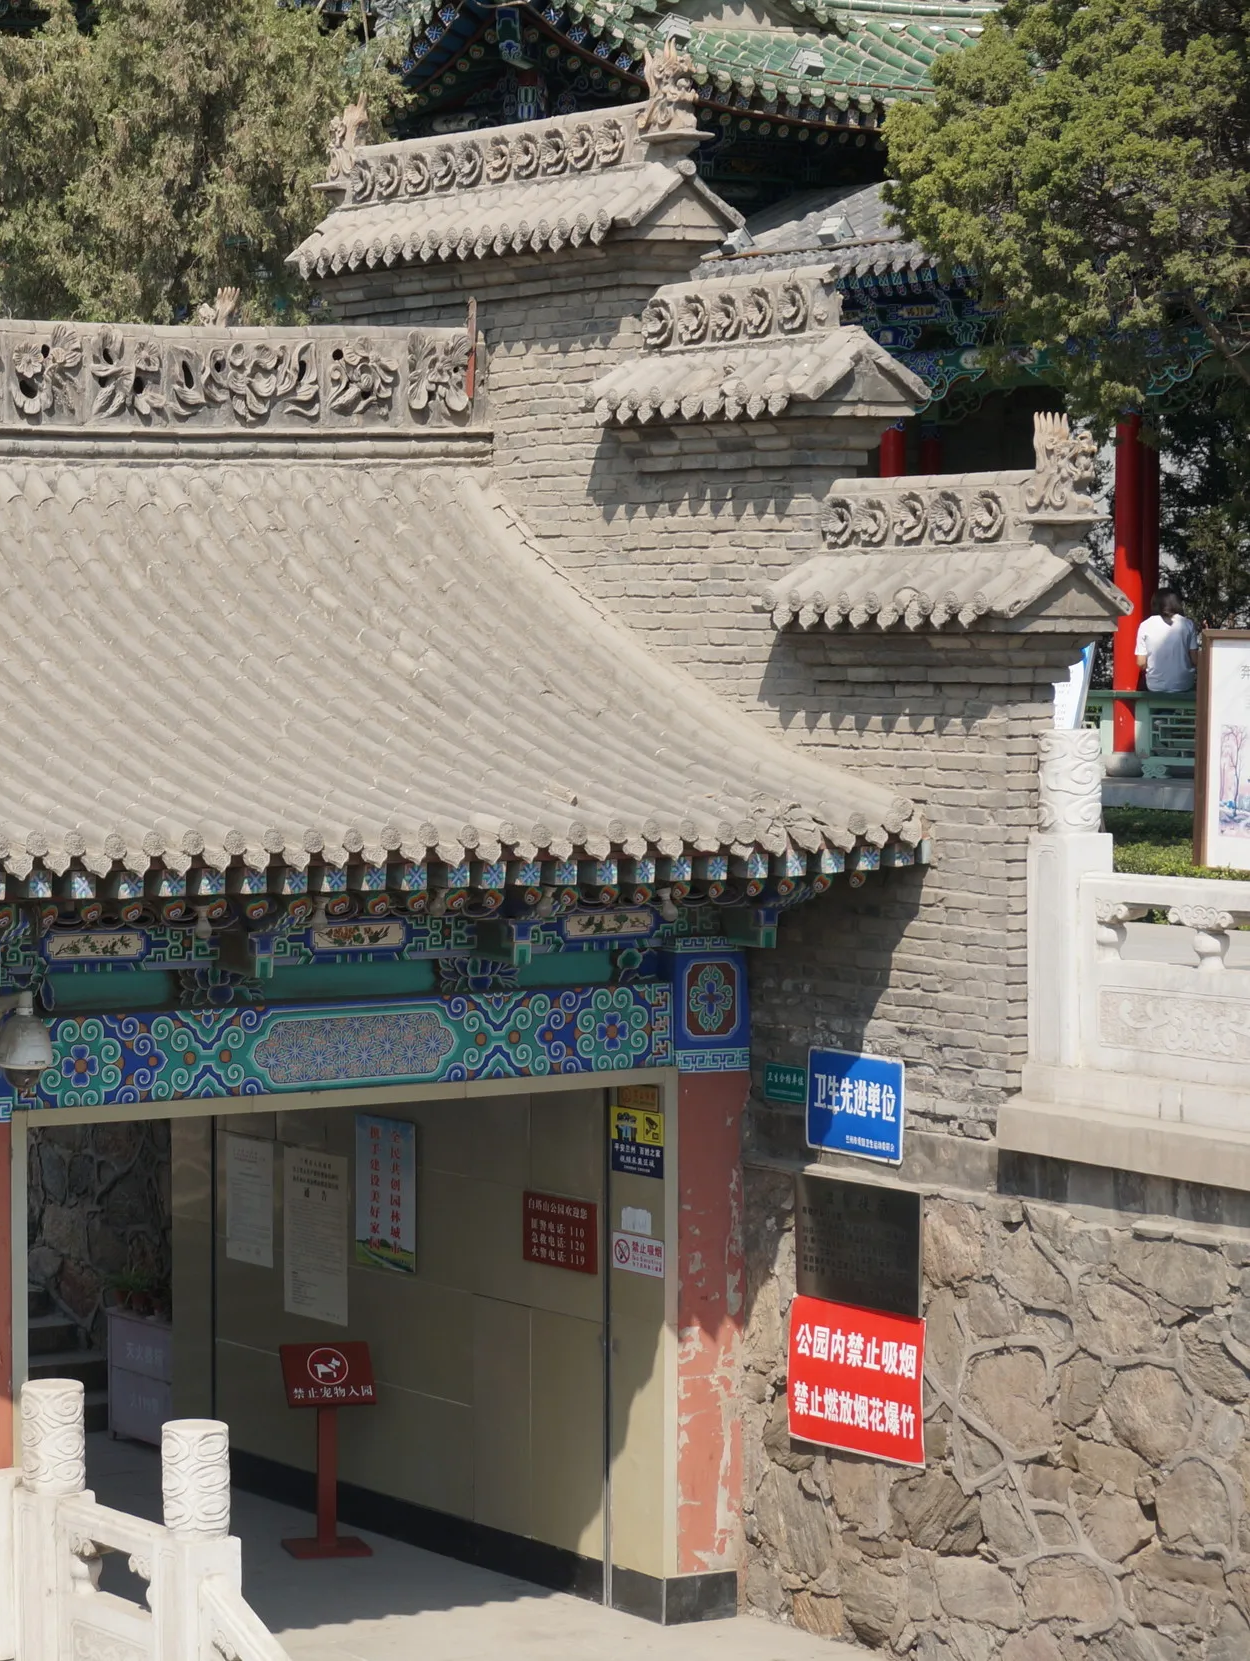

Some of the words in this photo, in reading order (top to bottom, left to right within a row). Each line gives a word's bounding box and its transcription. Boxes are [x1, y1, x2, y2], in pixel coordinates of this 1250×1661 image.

[813, 1072, 897, 1123] 卫生先进单位
[390, 1129, 401, 1255] 全民共创园林城市
[528, 1197, 588, 1220] 白塔山公园欢迎您
[570, 1226, 585, 1238] 110
[570, 1239, 585, 1252] 120
[632, 1240, 663, 1258] 禁止吸烟
[570, 1253, 585, 1266] 119
[795, 1322, 918, 1380] 公园内禁止吸烟
[293, 1384, 373, 1400] 禁止宠物入园
[793, 1380, 916, 1441] 禁止燃放烟花爆竹
